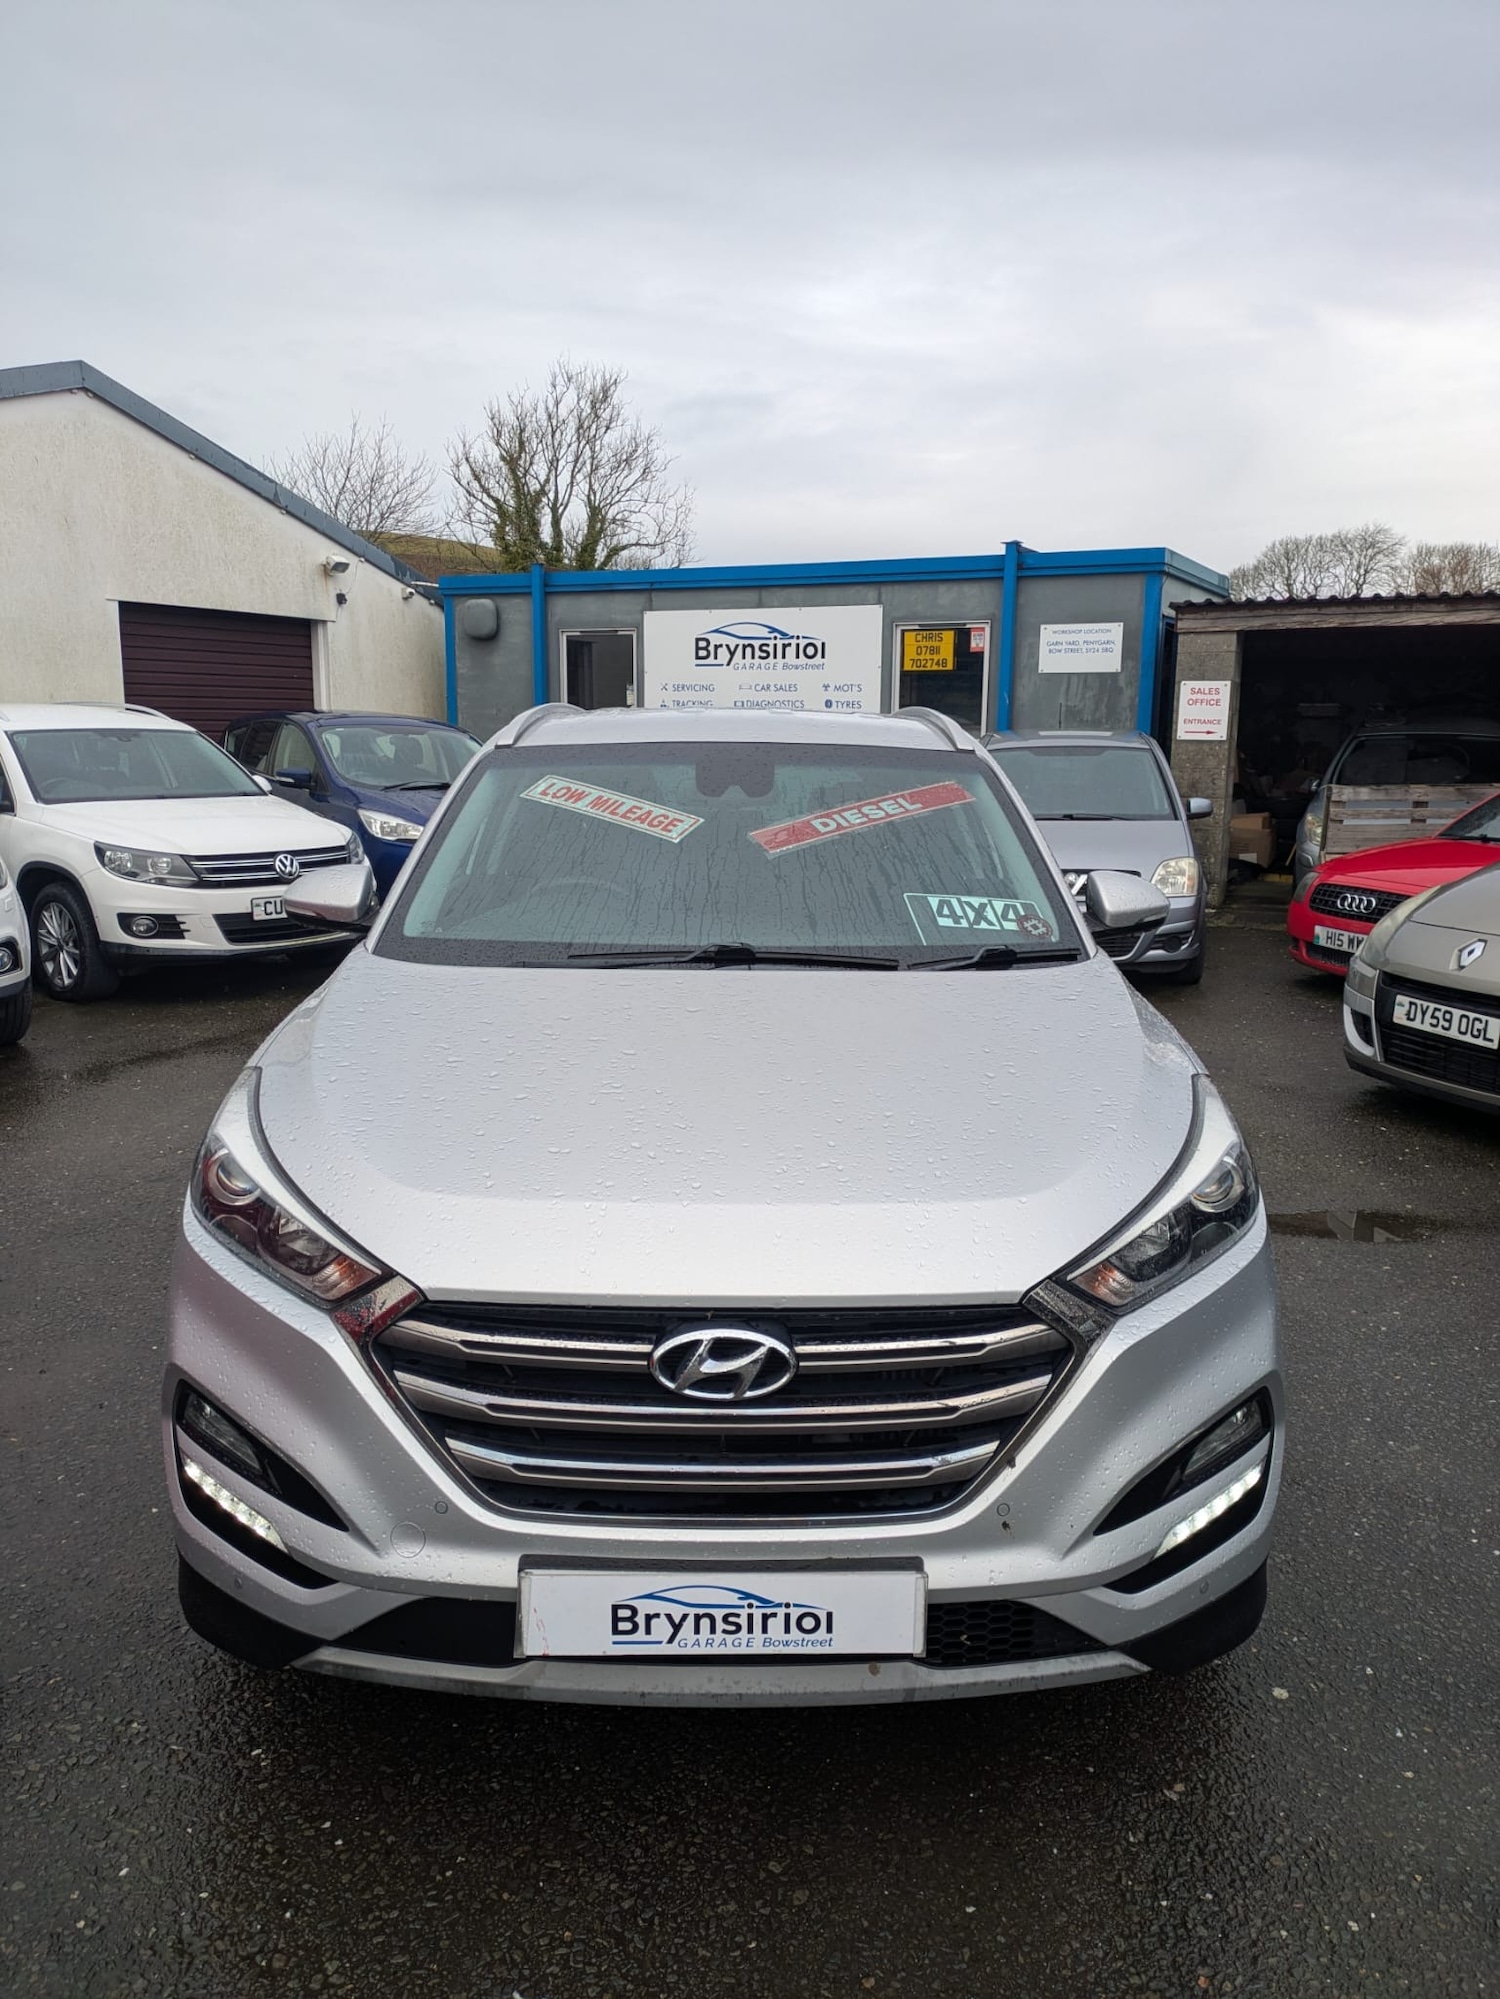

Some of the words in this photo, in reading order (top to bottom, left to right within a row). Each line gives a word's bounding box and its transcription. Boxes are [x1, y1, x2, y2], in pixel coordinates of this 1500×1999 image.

[915, 632, 943, 643] CHRIS
[916, 645, 941, 656] 07811
[733, 662, 778, 671] GARAGE
[782, 662, 825, 671] Bowstreet
[909, 658, 948, 669] 702748
[672, 683, 715, 693] SERVICING
[754, 683, 772, 693] CAR
[773, 683, 798, 693] SALES
[833, 683, 863, 693] MOT'S
[1190, 687, 1221, 696] SALES
[746, 700, 805, 709] DIAGNOSTICS
[835, 700, 862, 709] TYRES
[1187, 698, 1222, 707] OFFICE
[1183, 718, 1222, 726] ENTRANCE
[539, 781, 585, 805] LOW
[586, 793, 691, 835] MILEAGE
[809, 793, 924, 835] DIESEL
[1405, 1000, 1454, 1032] DY59
[1457, 1014, 1494, 1043] OGL
[677, 1637, 756, 1649] GARAGE
[762, 1636, 833, 1648] Bowstreet
